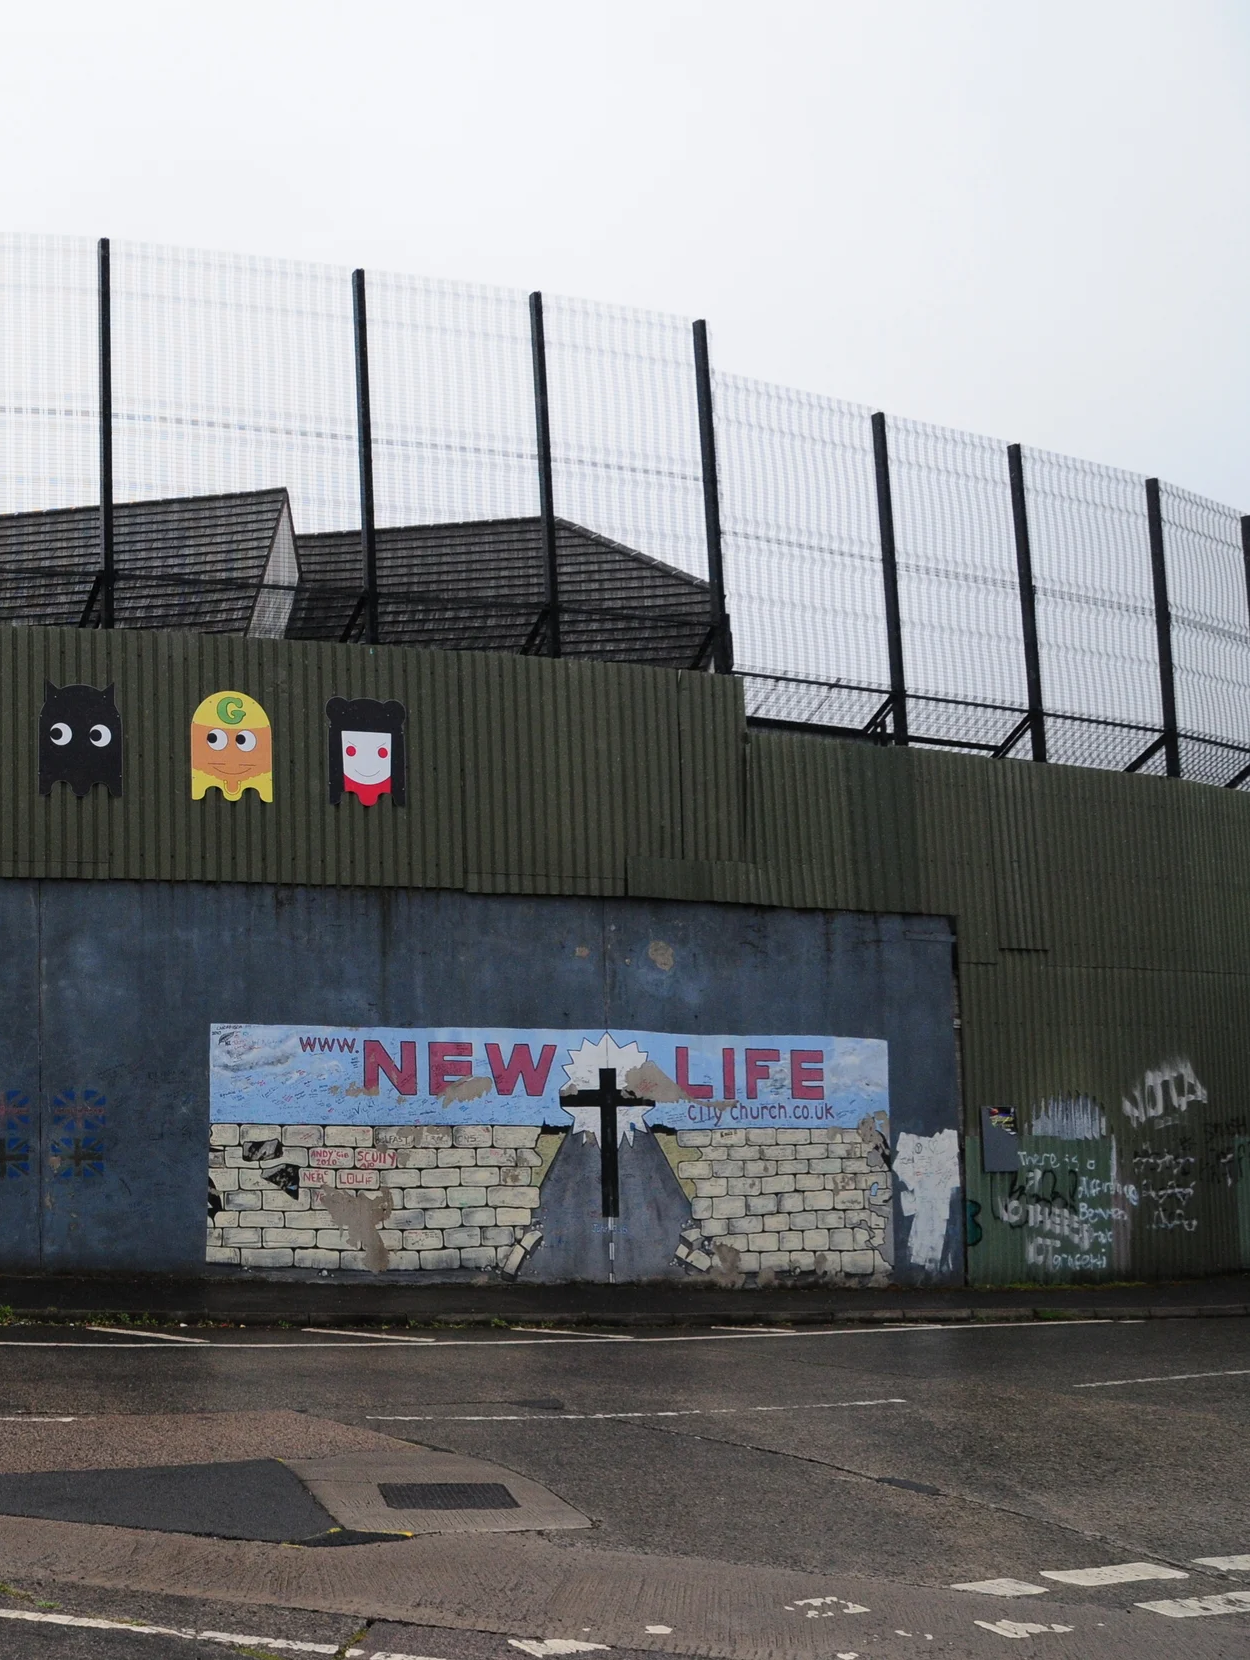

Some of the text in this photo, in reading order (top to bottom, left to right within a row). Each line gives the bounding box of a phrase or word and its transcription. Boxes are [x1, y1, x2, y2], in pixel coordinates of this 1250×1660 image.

[217, 697, 246, 724] G
[299, 1036, 360, 1054] www.
[363, 1039, 558, 1097] NEW
[675, 1046, 825, 1100] LIFE
[729, 1102, 836, 1120] church.co.uk
